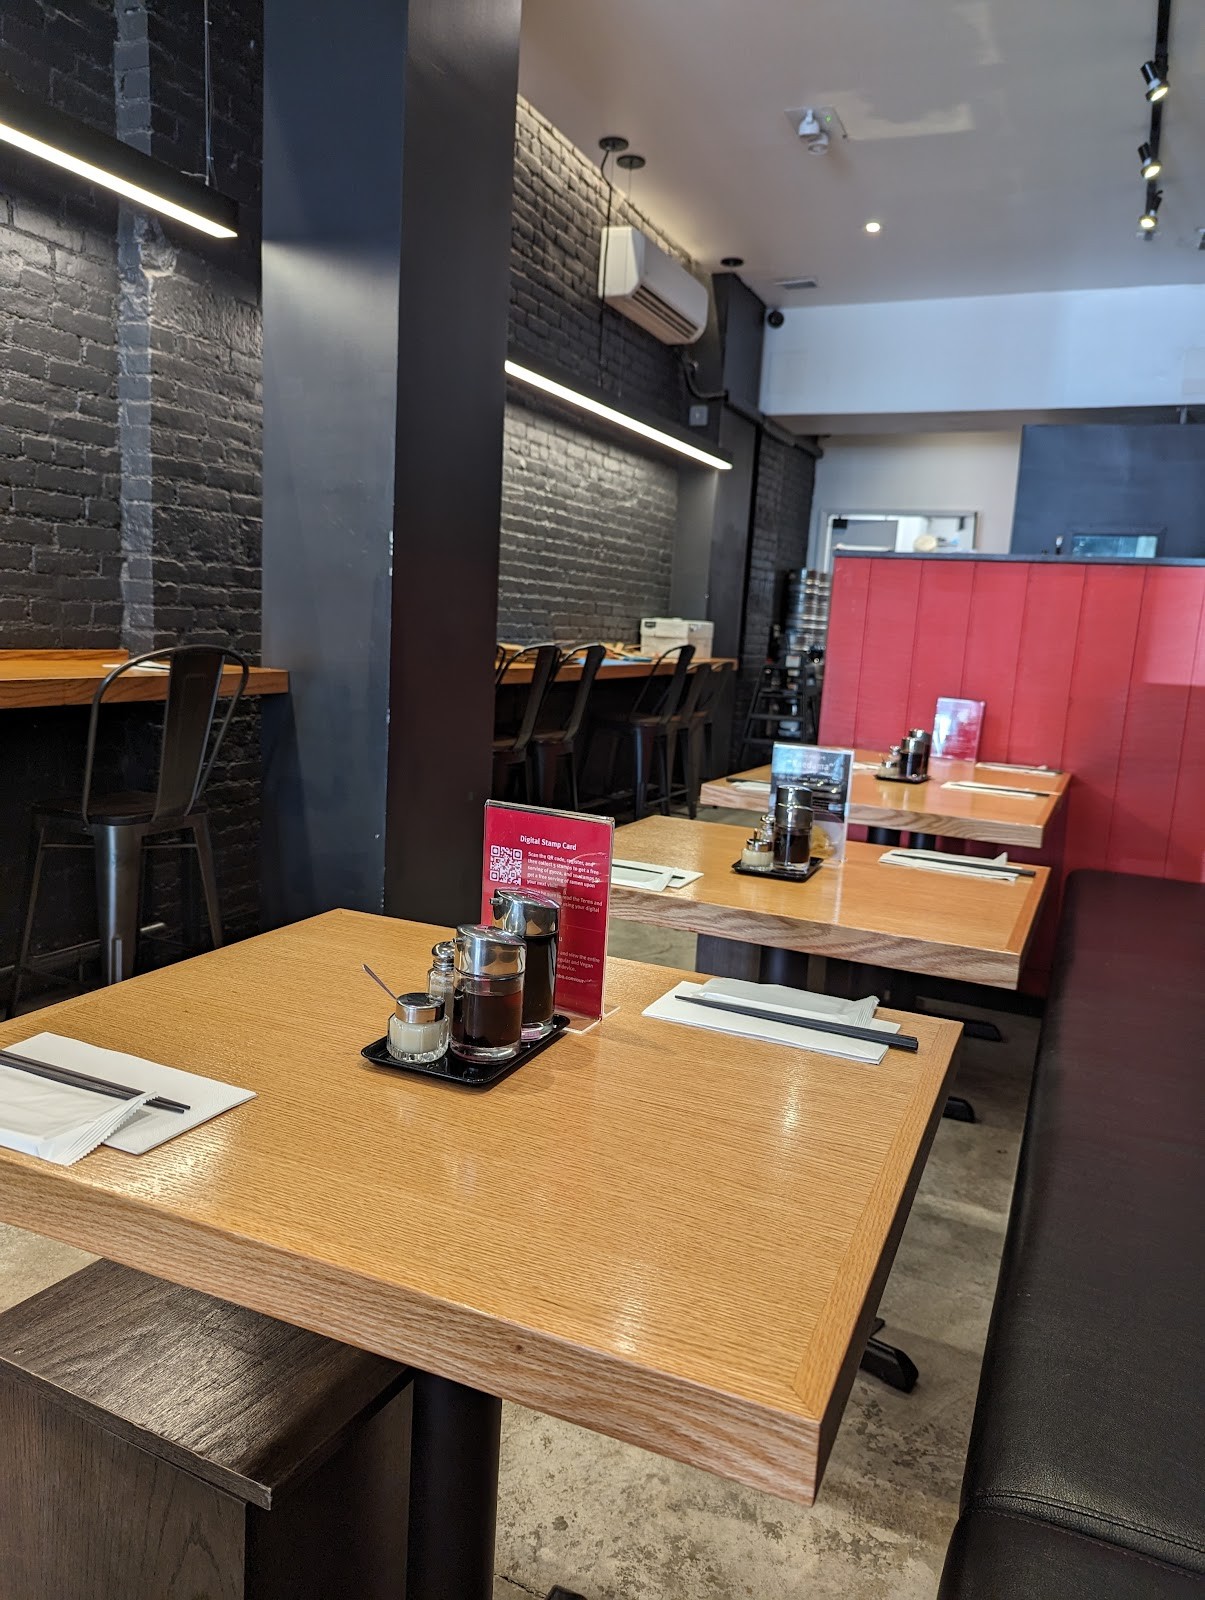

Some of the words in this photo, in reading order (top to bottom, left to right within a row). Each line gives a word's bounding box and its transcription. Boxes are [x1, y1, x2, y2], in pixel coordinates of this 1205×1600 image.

[520, 835, 540, 845] Digital
[541, 838, 562, 849] Stamp
[562, 842, 577, 850] Card
[548, 876, 564, 884] serving
